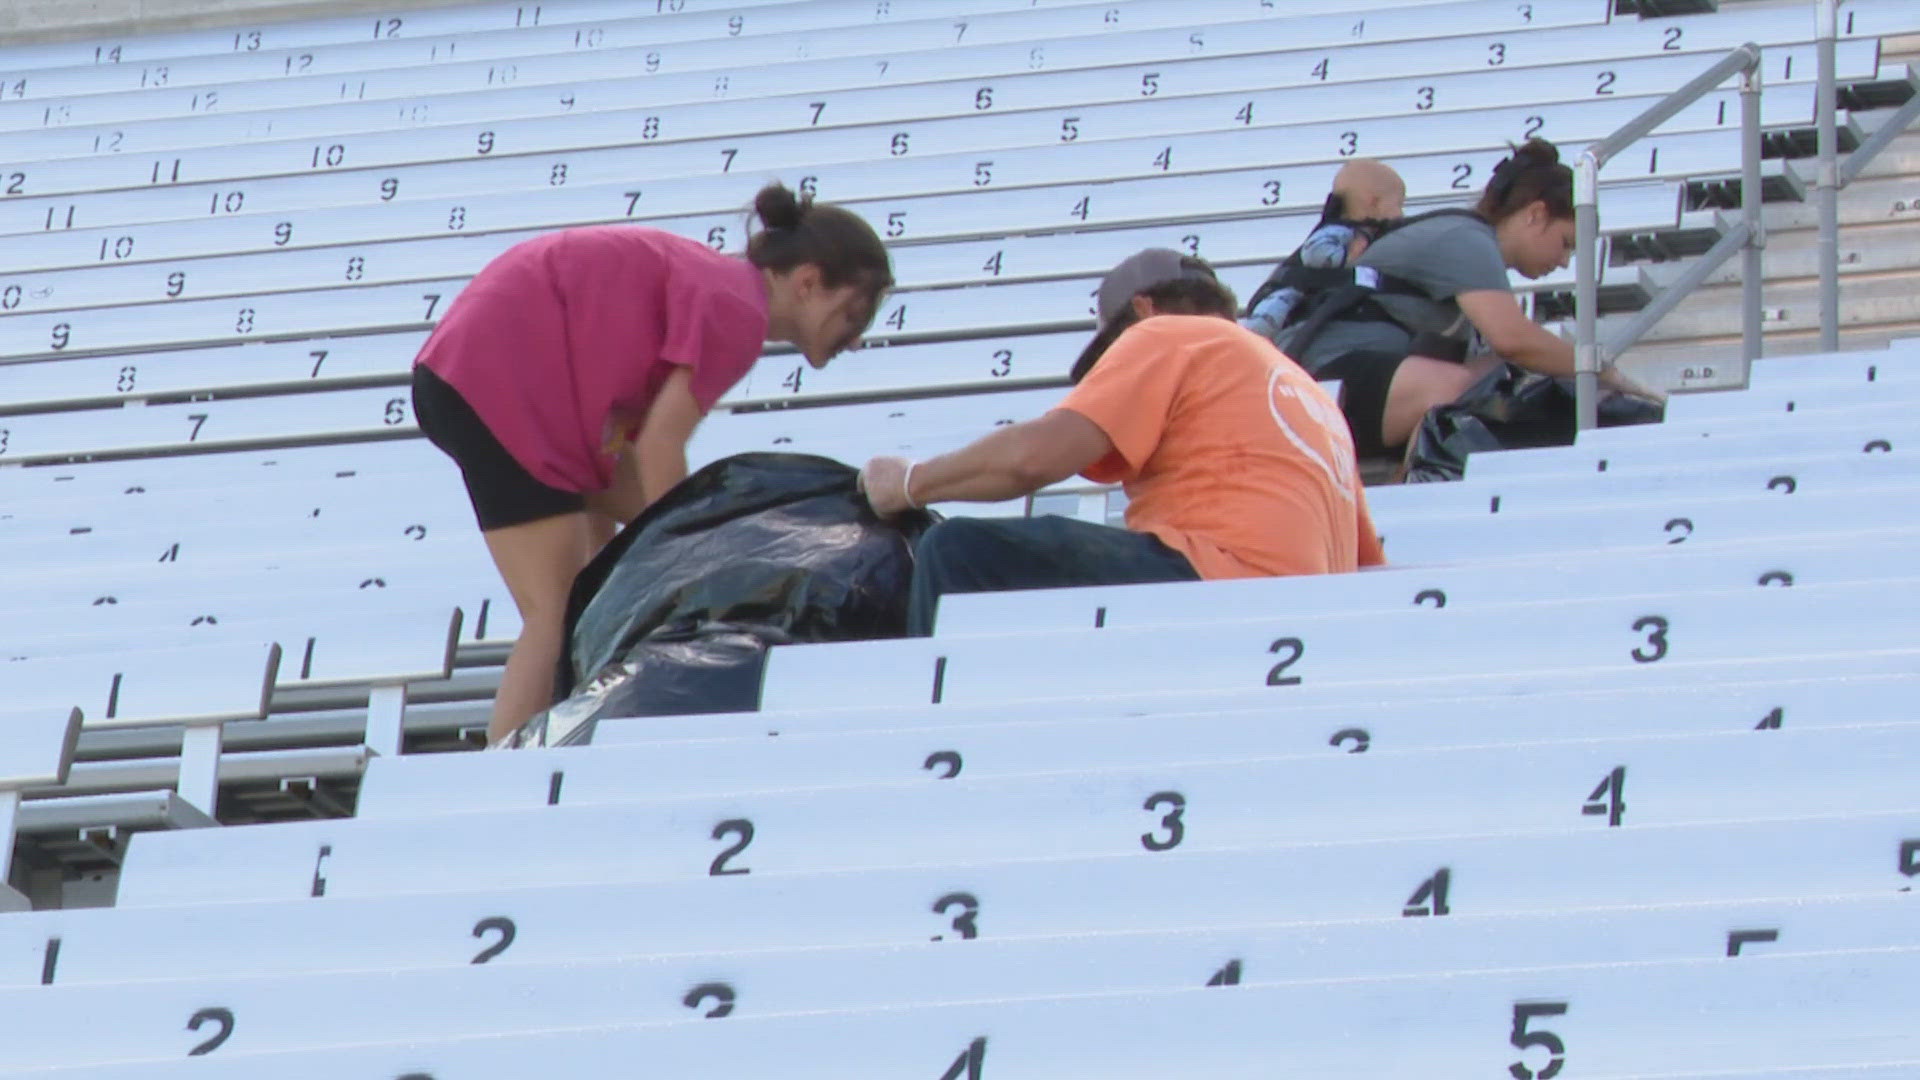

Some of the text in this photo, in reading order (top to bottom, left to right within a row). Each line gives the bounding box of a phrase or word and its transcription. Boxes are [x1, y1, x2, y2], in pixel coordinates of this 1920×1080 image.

[95, 45, 123, 64] 14
[234, 31, 262, 51] 13
[374, 18, 402, 38] 12
[516, 7, 541, 27] 11
[191, 92, 218, 112] 12
[341, 80, 366, 98] 11
[646, 52, 660, 71] 9
[953, 23, 969, 42] 7
[285, 55, 313, 74] 12
[728, 16, 744, 35] 9
[94, 132, 123, 152] 12
[875, 61, 889, 76] 7
[152, 159, 180, 183] 11
[312, 145, 344, 167] 10
[478, 131, 495, 154] 9
[642, 117, 659, 139] 8
[810, 102, 827, 126] 7
[976, 88, 993, 110] 6
[1142, 73, 1160, 96] 5
[1312, 59, 1329, 80] 4
[1488, 43, 1505, 66] 3
[1664, 27, 1681, 49] 2
[1847, 11, 1854, 34] 1
[45, 56, 1791, 230] 11 10 9 8 7 6 5 4 3 2 1
[99, 236, 134, 260] 10
[275, 222, 292, 246] 9
[448, 206, 466, 230] 8
[625, 191, 641, 216] 7
[974, 162, 993, 186] 5
[1154, 147, 1172, 171] 4
[1340, 132, 1358, 155] 3
[1525, 116, 1543, 139] 2
[1718, 101, 1725, 125] 1
[166, 272, 184, 296] 9
[346, 258, 363, 281] 8
[707, 226, 726, 251] 6
[888, 212, 906, 237] 5
[1071, 196, 1089, 220] 4
[1262, 180, 1280, 205] 3
[1453, 164, 1472, 188] 2
[1650, 148, 1657, 173] 1
[51, 324, 70, 350] 9
[236, 309, 255, 332] 8
[423, 295, 441, 320] 7
[983, 251, 1003, 276] 4
[117, 305, 905, 392] 8 7 4
[188, 350, 1011, 441] 7 6 4 3
[106, 673, 122, 718] 1
[301, 638, 315, 679] 1
[932, 615, 1668, 704] 1 2 3
[709, 819, 754, 876] 2
[1141, 791, 1185, 852] 3
[1581, 766, 1627, 826] 4
[43, 940, 59, 984] 1
[1403, 867, 1451, 916] 4
[1509, 1002, 1568, 1080] 5
